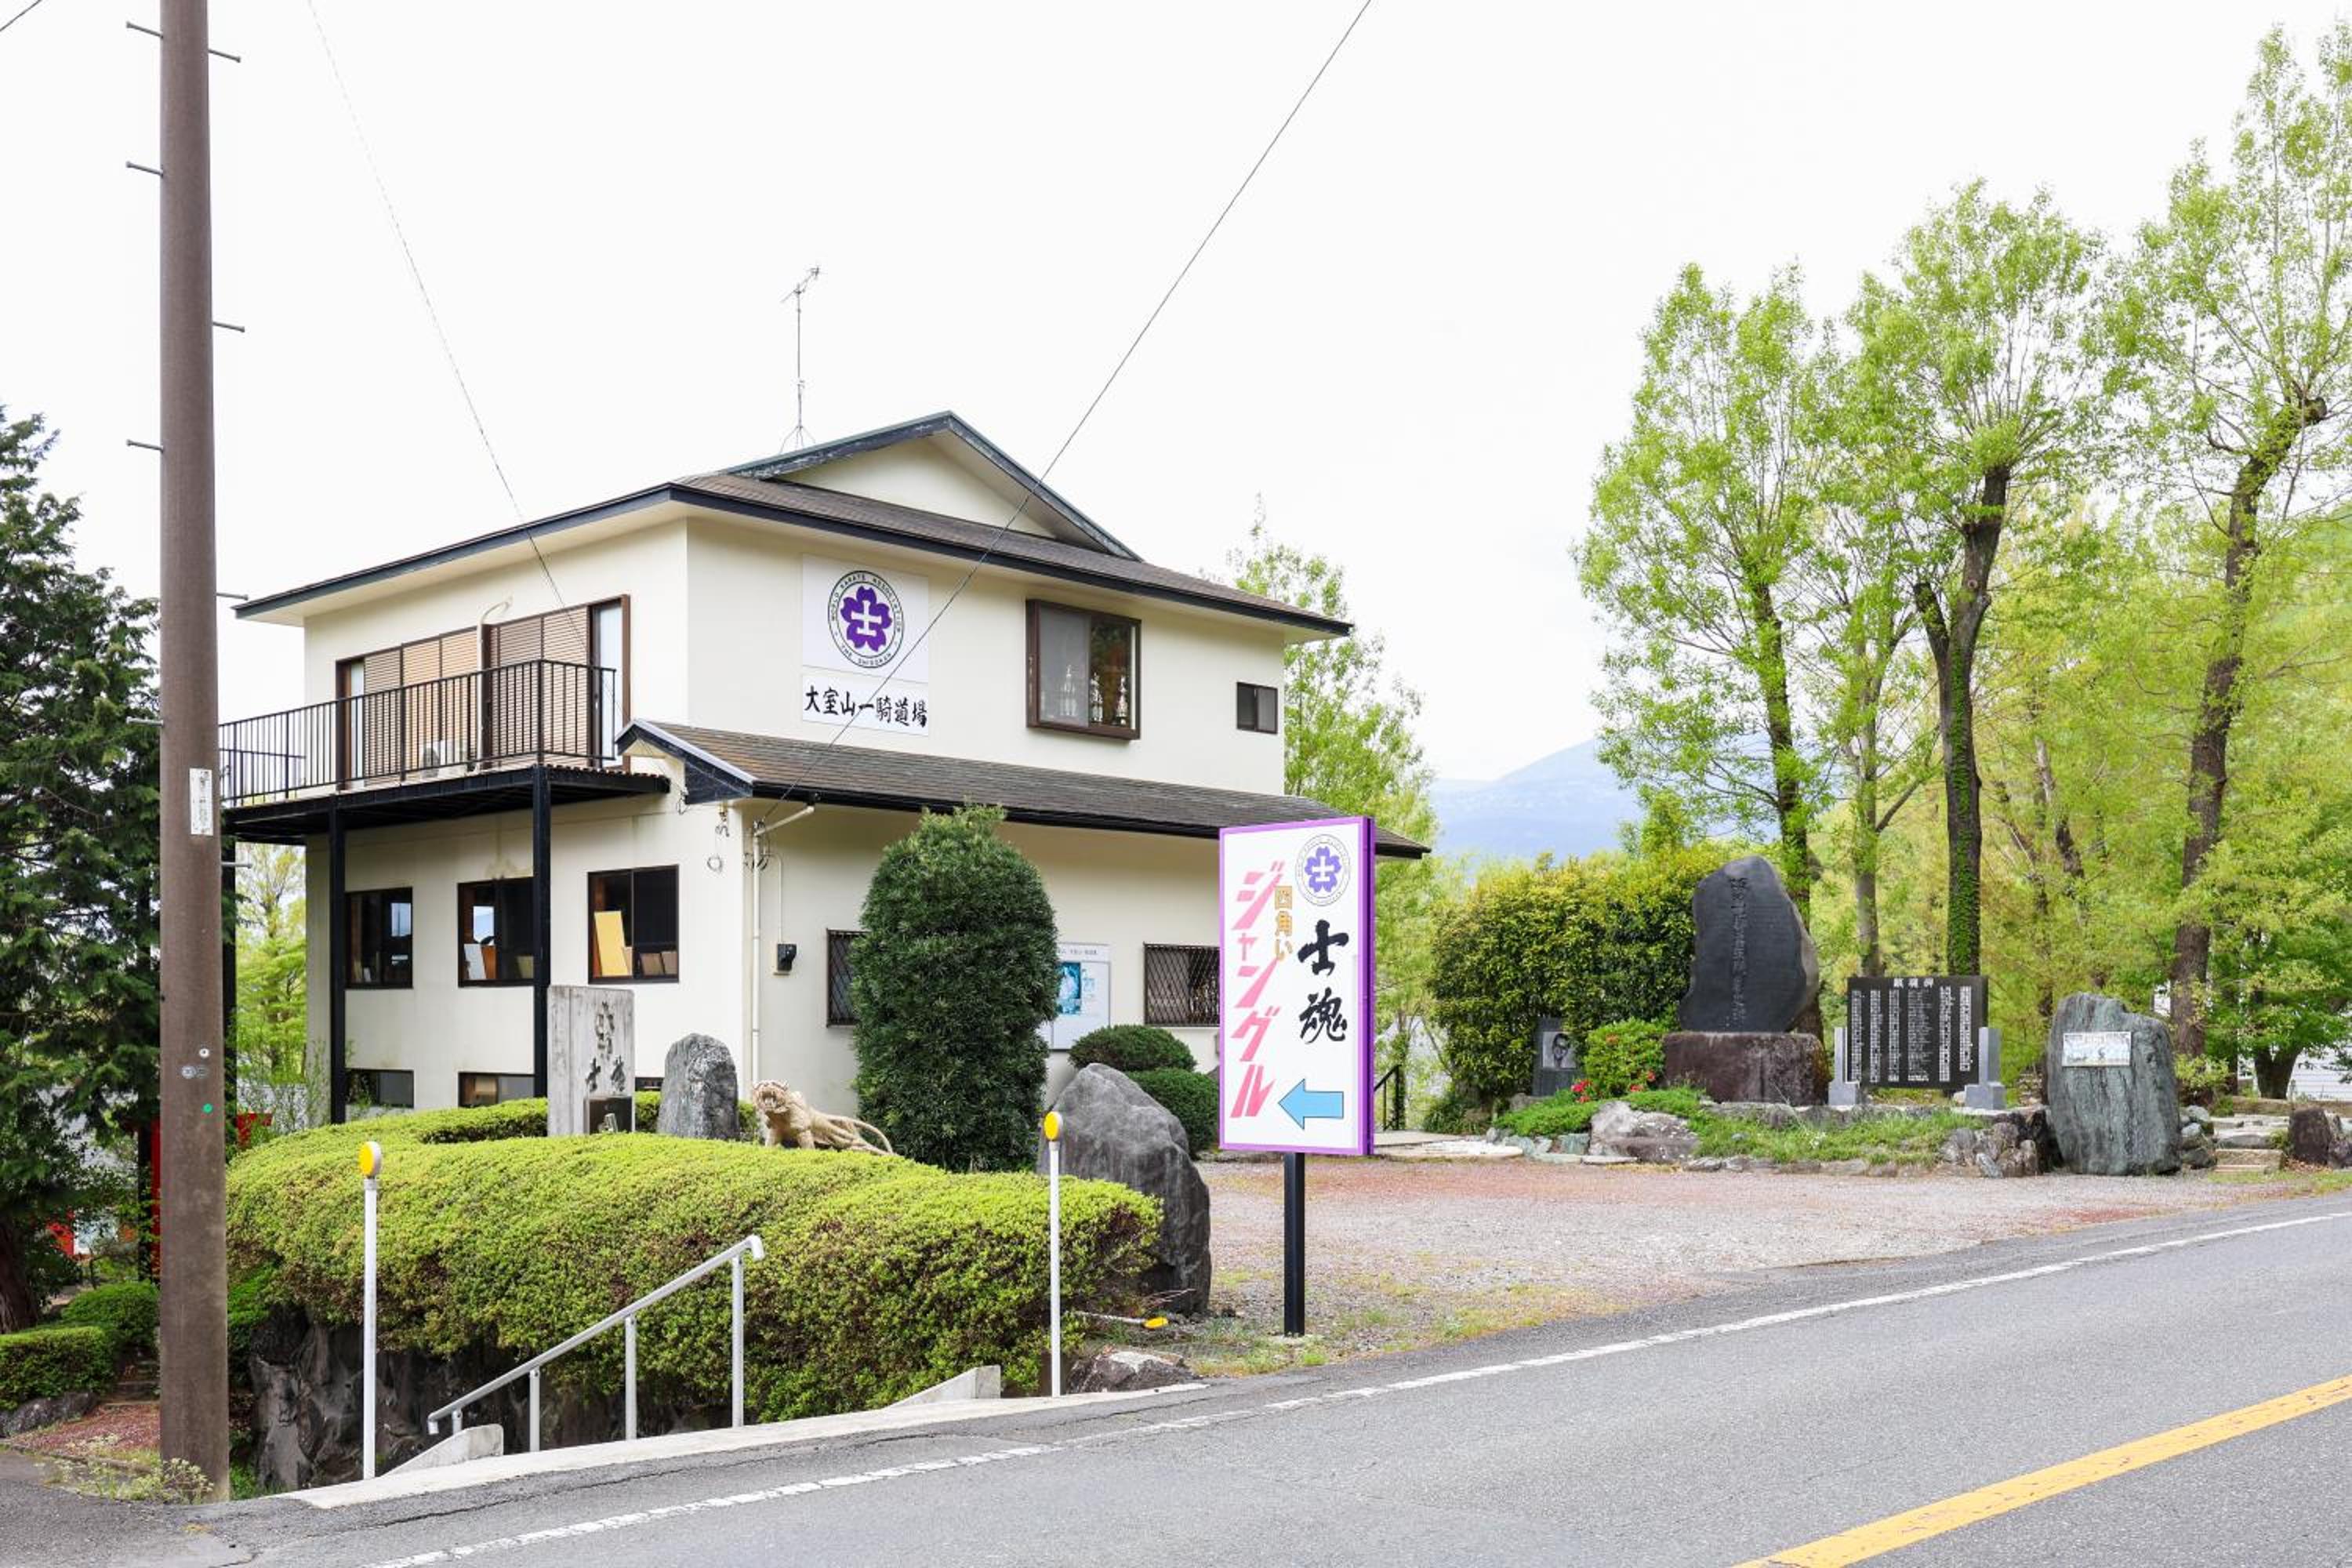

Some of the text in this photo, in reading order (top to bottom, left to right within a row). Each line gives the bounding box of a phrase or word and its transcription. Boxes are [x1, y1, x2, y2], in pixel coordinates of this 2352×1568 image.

[840, 575, 866, 589] KARATE
[804, 685, 927, 728] 大室山一騎道場
[1274, 885, 1294, 962] 四角い
[1231, 861, 1284, 1119] ジャングル
[1298, 920, 1349, 1044] 士魂
